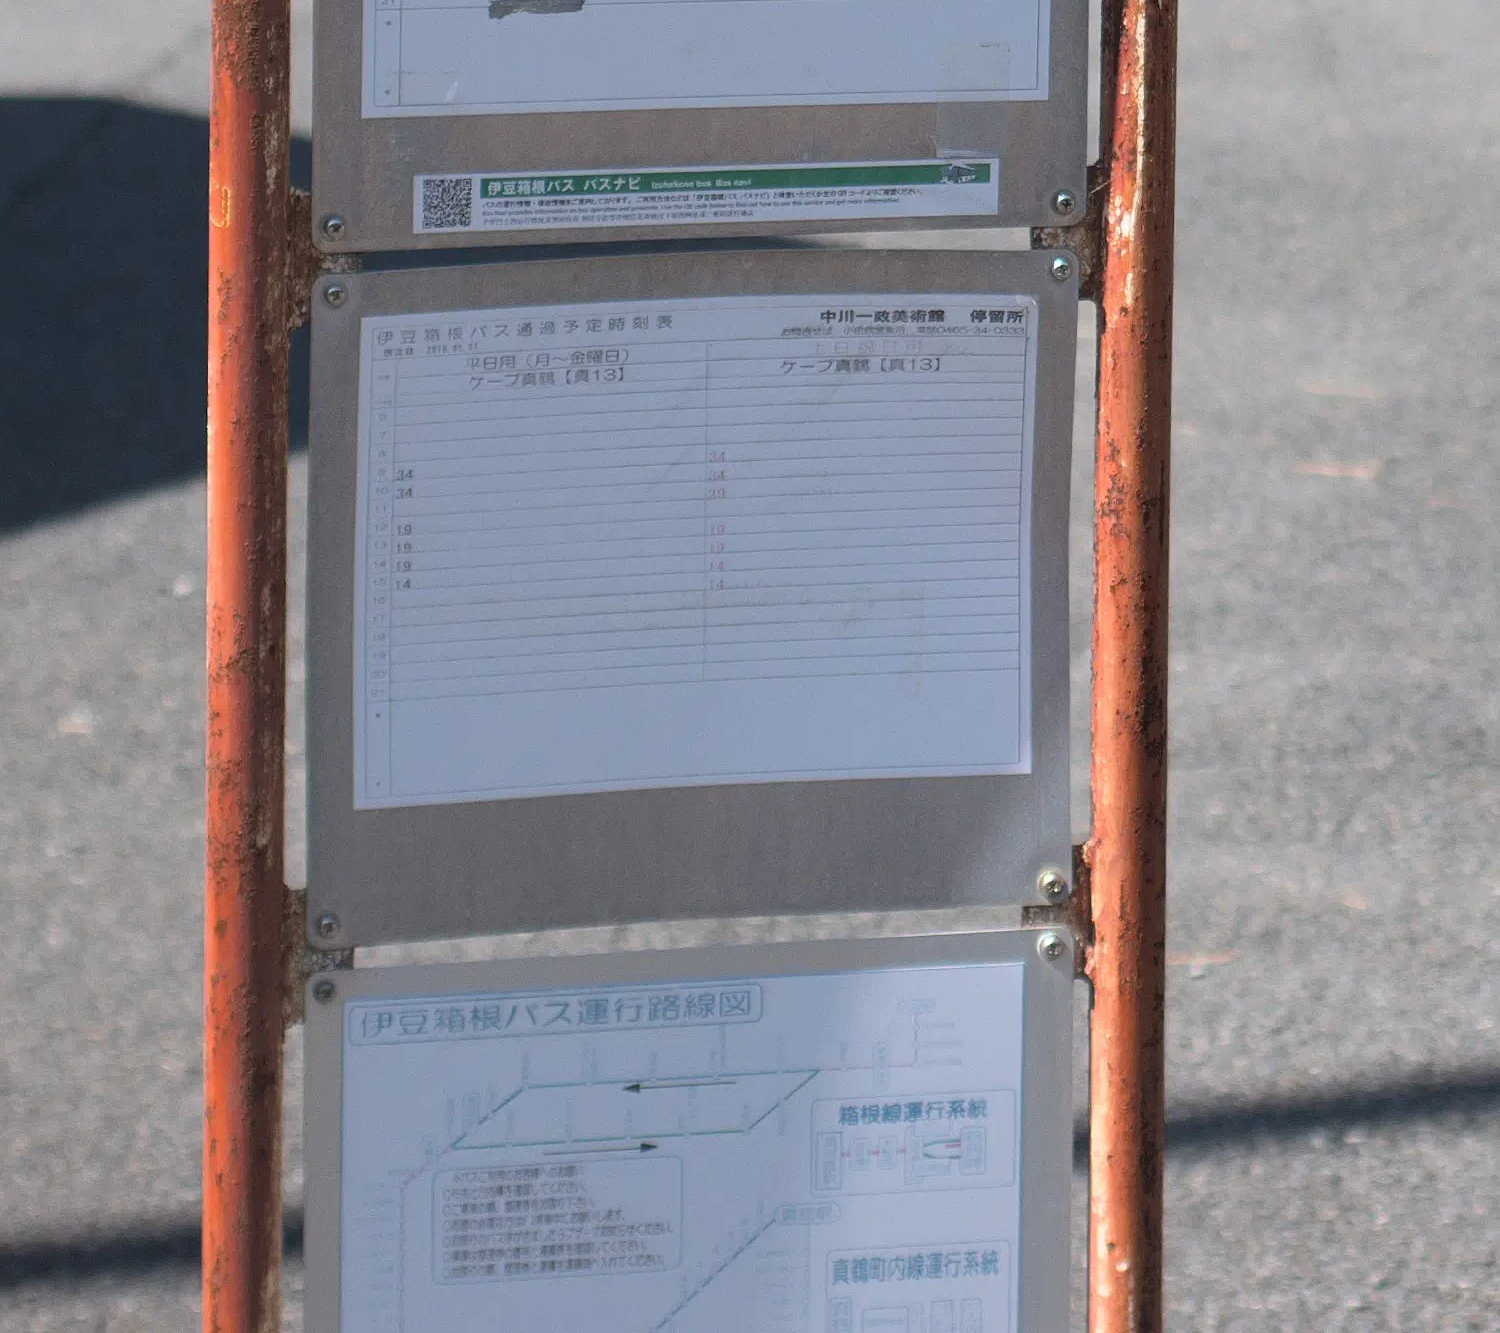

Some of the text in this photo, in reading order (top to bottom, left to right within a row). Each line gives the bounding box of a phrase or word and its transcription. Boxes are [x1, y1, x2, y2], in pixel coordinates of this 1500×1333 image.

[377, 315, 672, 346] 伊豆箱根バス通過予定時刻表
[821, 309, 1023, 323] 中川一政美術館 停留所
[361, 991, 750, 1039] 伊豆箱根バス運行路線図
